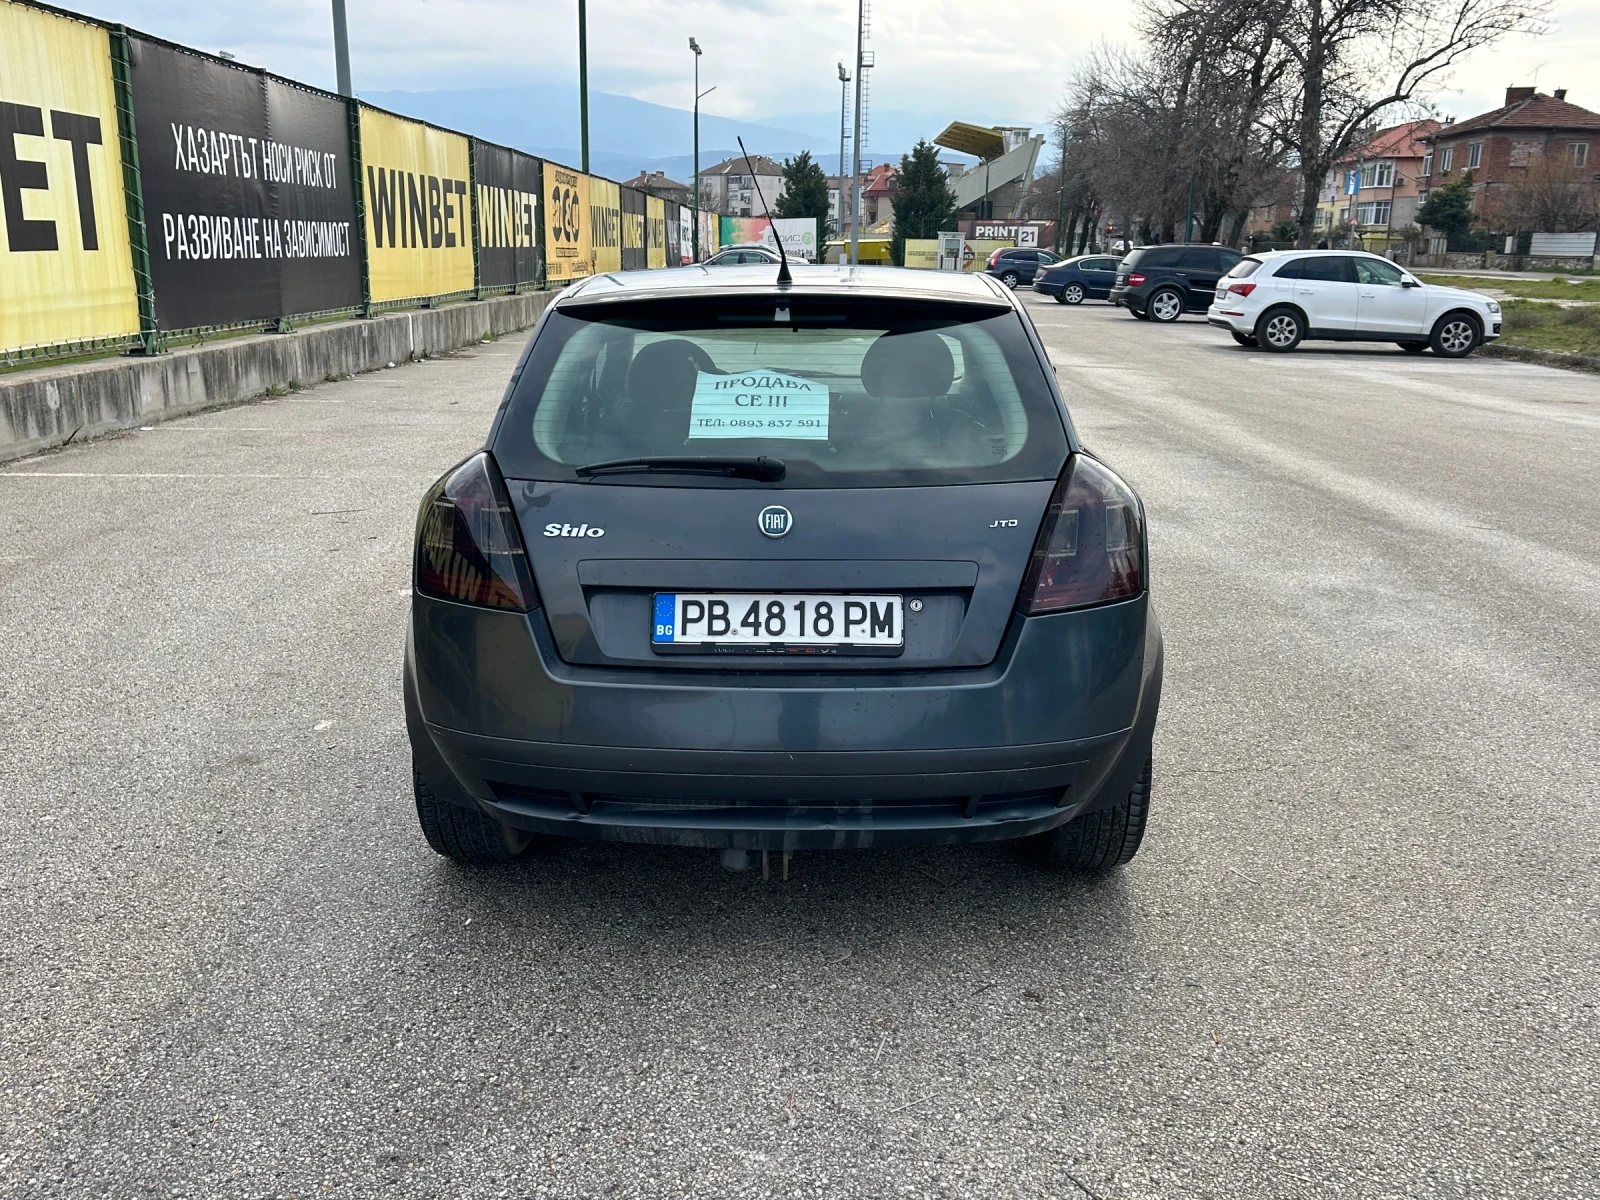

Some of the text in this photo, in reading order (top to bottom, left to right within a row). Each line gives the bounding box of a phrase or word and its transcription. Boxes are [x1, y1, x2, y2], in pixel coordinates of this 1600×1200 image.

[171, 122, 337, 189] ХАЗАРТЪТ НОСИ РИСК ОТ
[0, 101, 103, 252] ET
[366, 165, 467, 249] WINBET
[476, 183, 537, 248] WINBET
[590, 205, 619, 248] WINBET
[621, 211, 645, 249] WINBET
[975, 225, 1018, 238] PRINT
[162, 212, 350, 260] РАЗВИВАНЕ НА ЗАВИСИМОСТ
[1021, 231, 1035, 243] 21
[714, 376, 812, 391] ПРОДАВА
[697, 418, 821, 428] ТЕЛ: 0893 837 591
[765, 514, 785, 529] FIAT
[989, 519, 1018, 528] JTD
[543, 523, 605, 538] Stilo
[656, 624, 673, 636] BG
